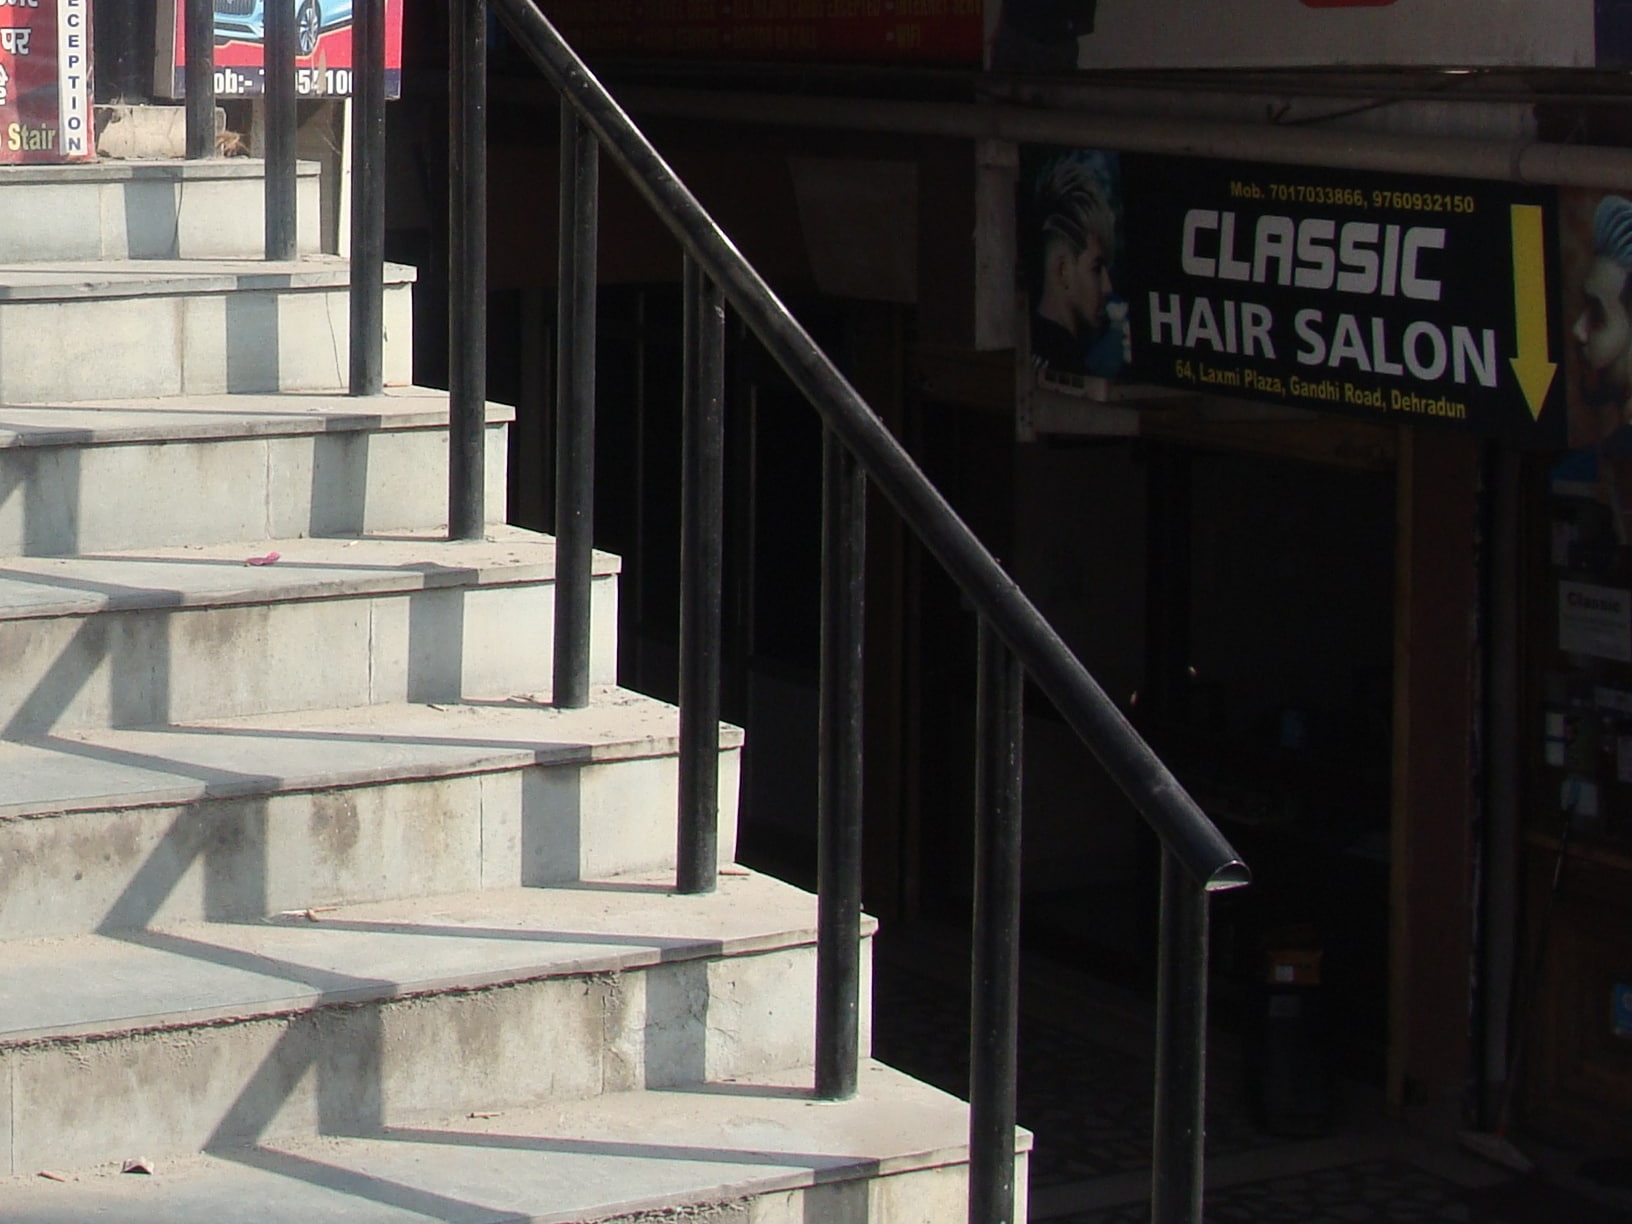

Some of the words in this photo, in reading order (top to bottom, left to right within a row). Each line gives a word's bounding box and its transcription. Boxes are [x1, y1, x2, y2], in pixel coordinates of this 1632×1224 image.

[0, 27, 31, 56] पर
[214, 69, 252, 95] ob:-
[7, 122, 56, 152] Stair
[1230, 180, 1265, 200] Mob.
[1182, 209, 1447, 301] CLASSIC
[1148, 290, 1278, 360] HAIR
[1293, 308, 1500, 389] SALON
[1199, 363, 1241, 388] Laxmi
[1244, 368, 1286, 397] Plaza,
[1289, 375, 1340, 402] Gandhi
[1344, 382, 1387, 412] Road,
[1390, 389, 1467, 420] Dehradun
